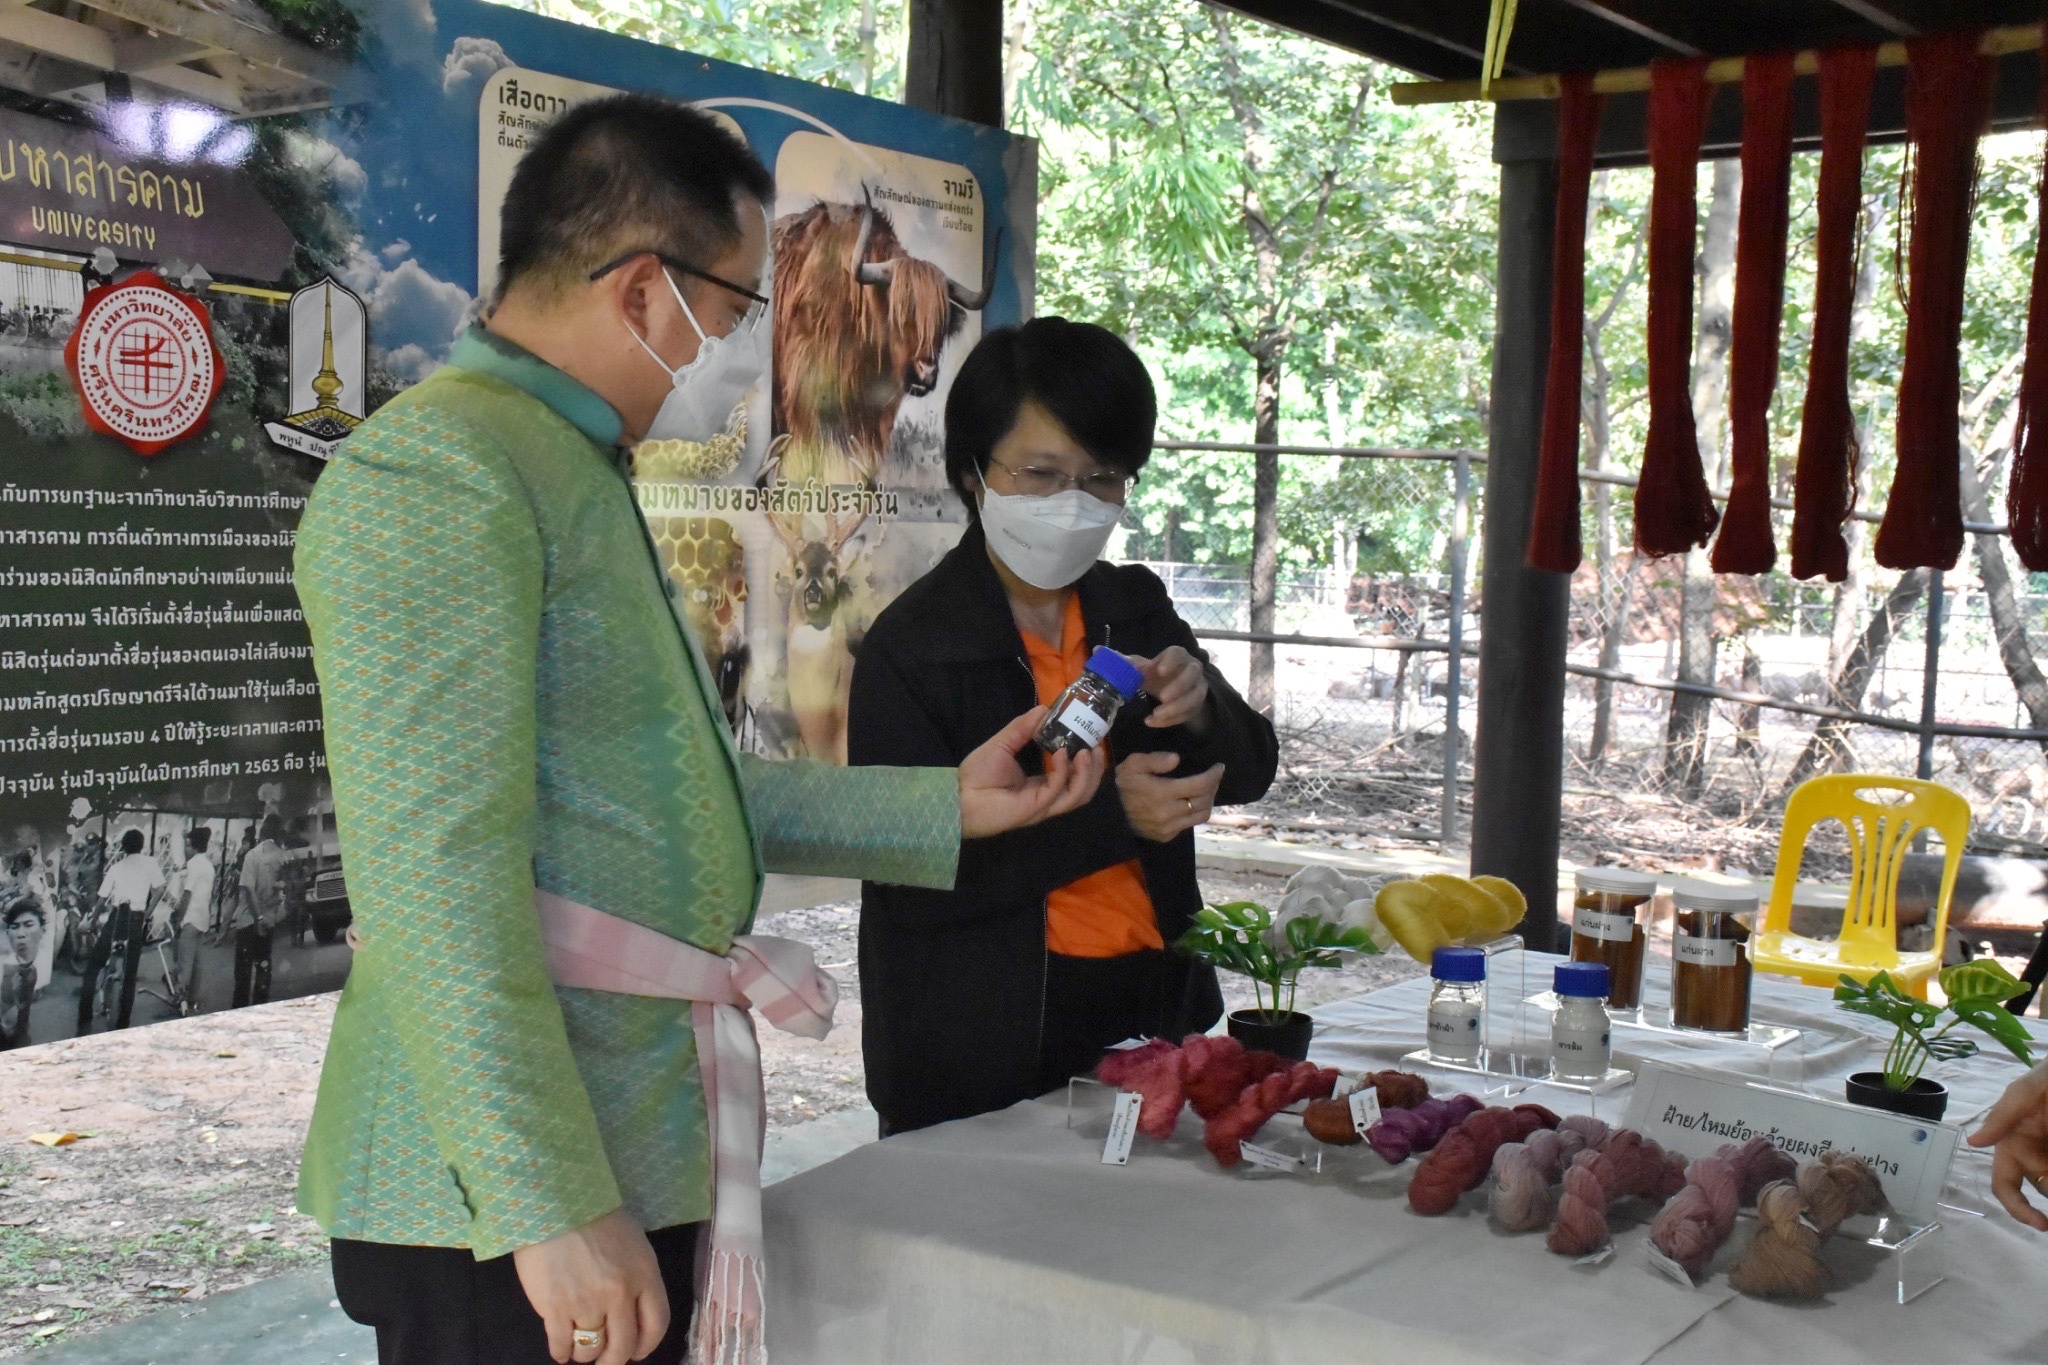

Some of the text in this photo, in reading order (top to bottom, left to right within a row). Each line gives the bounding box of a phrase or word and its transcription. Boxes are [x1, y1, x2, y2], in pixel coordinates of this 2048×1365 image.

[944, 178, 974, 199] จามรี
[32, 206, 155, 250] UNIVERSITY
[100, 298, 193, 343] มหาวิทยาลัย
[0, 483, 308, 509] กับการยกฐานะจากวิทยาลัยวิชาการศึกษา
[91, 601, 303, 629] จึงได้ริเริ่มตั้งชื่อรุ่นขึ้นเพื่อแสด
[0, 678, 321, 714] มหลักสูตรปริญญาตรีจึงได้วนมาใช้รุ่นเสือดา
[151, 730, 160, 744] 4
[164, 718, 323, 746] ปีให้รู้ระยะเวลาและควา
[61, 758, 240, 795] รุ่นปัจจุบันในปีการศึกษา
[245, 758, 279, 775] 2563
[284, 751, 303, 771] คือ
[1681, 945, 1714, 957] แก่นฝาง
